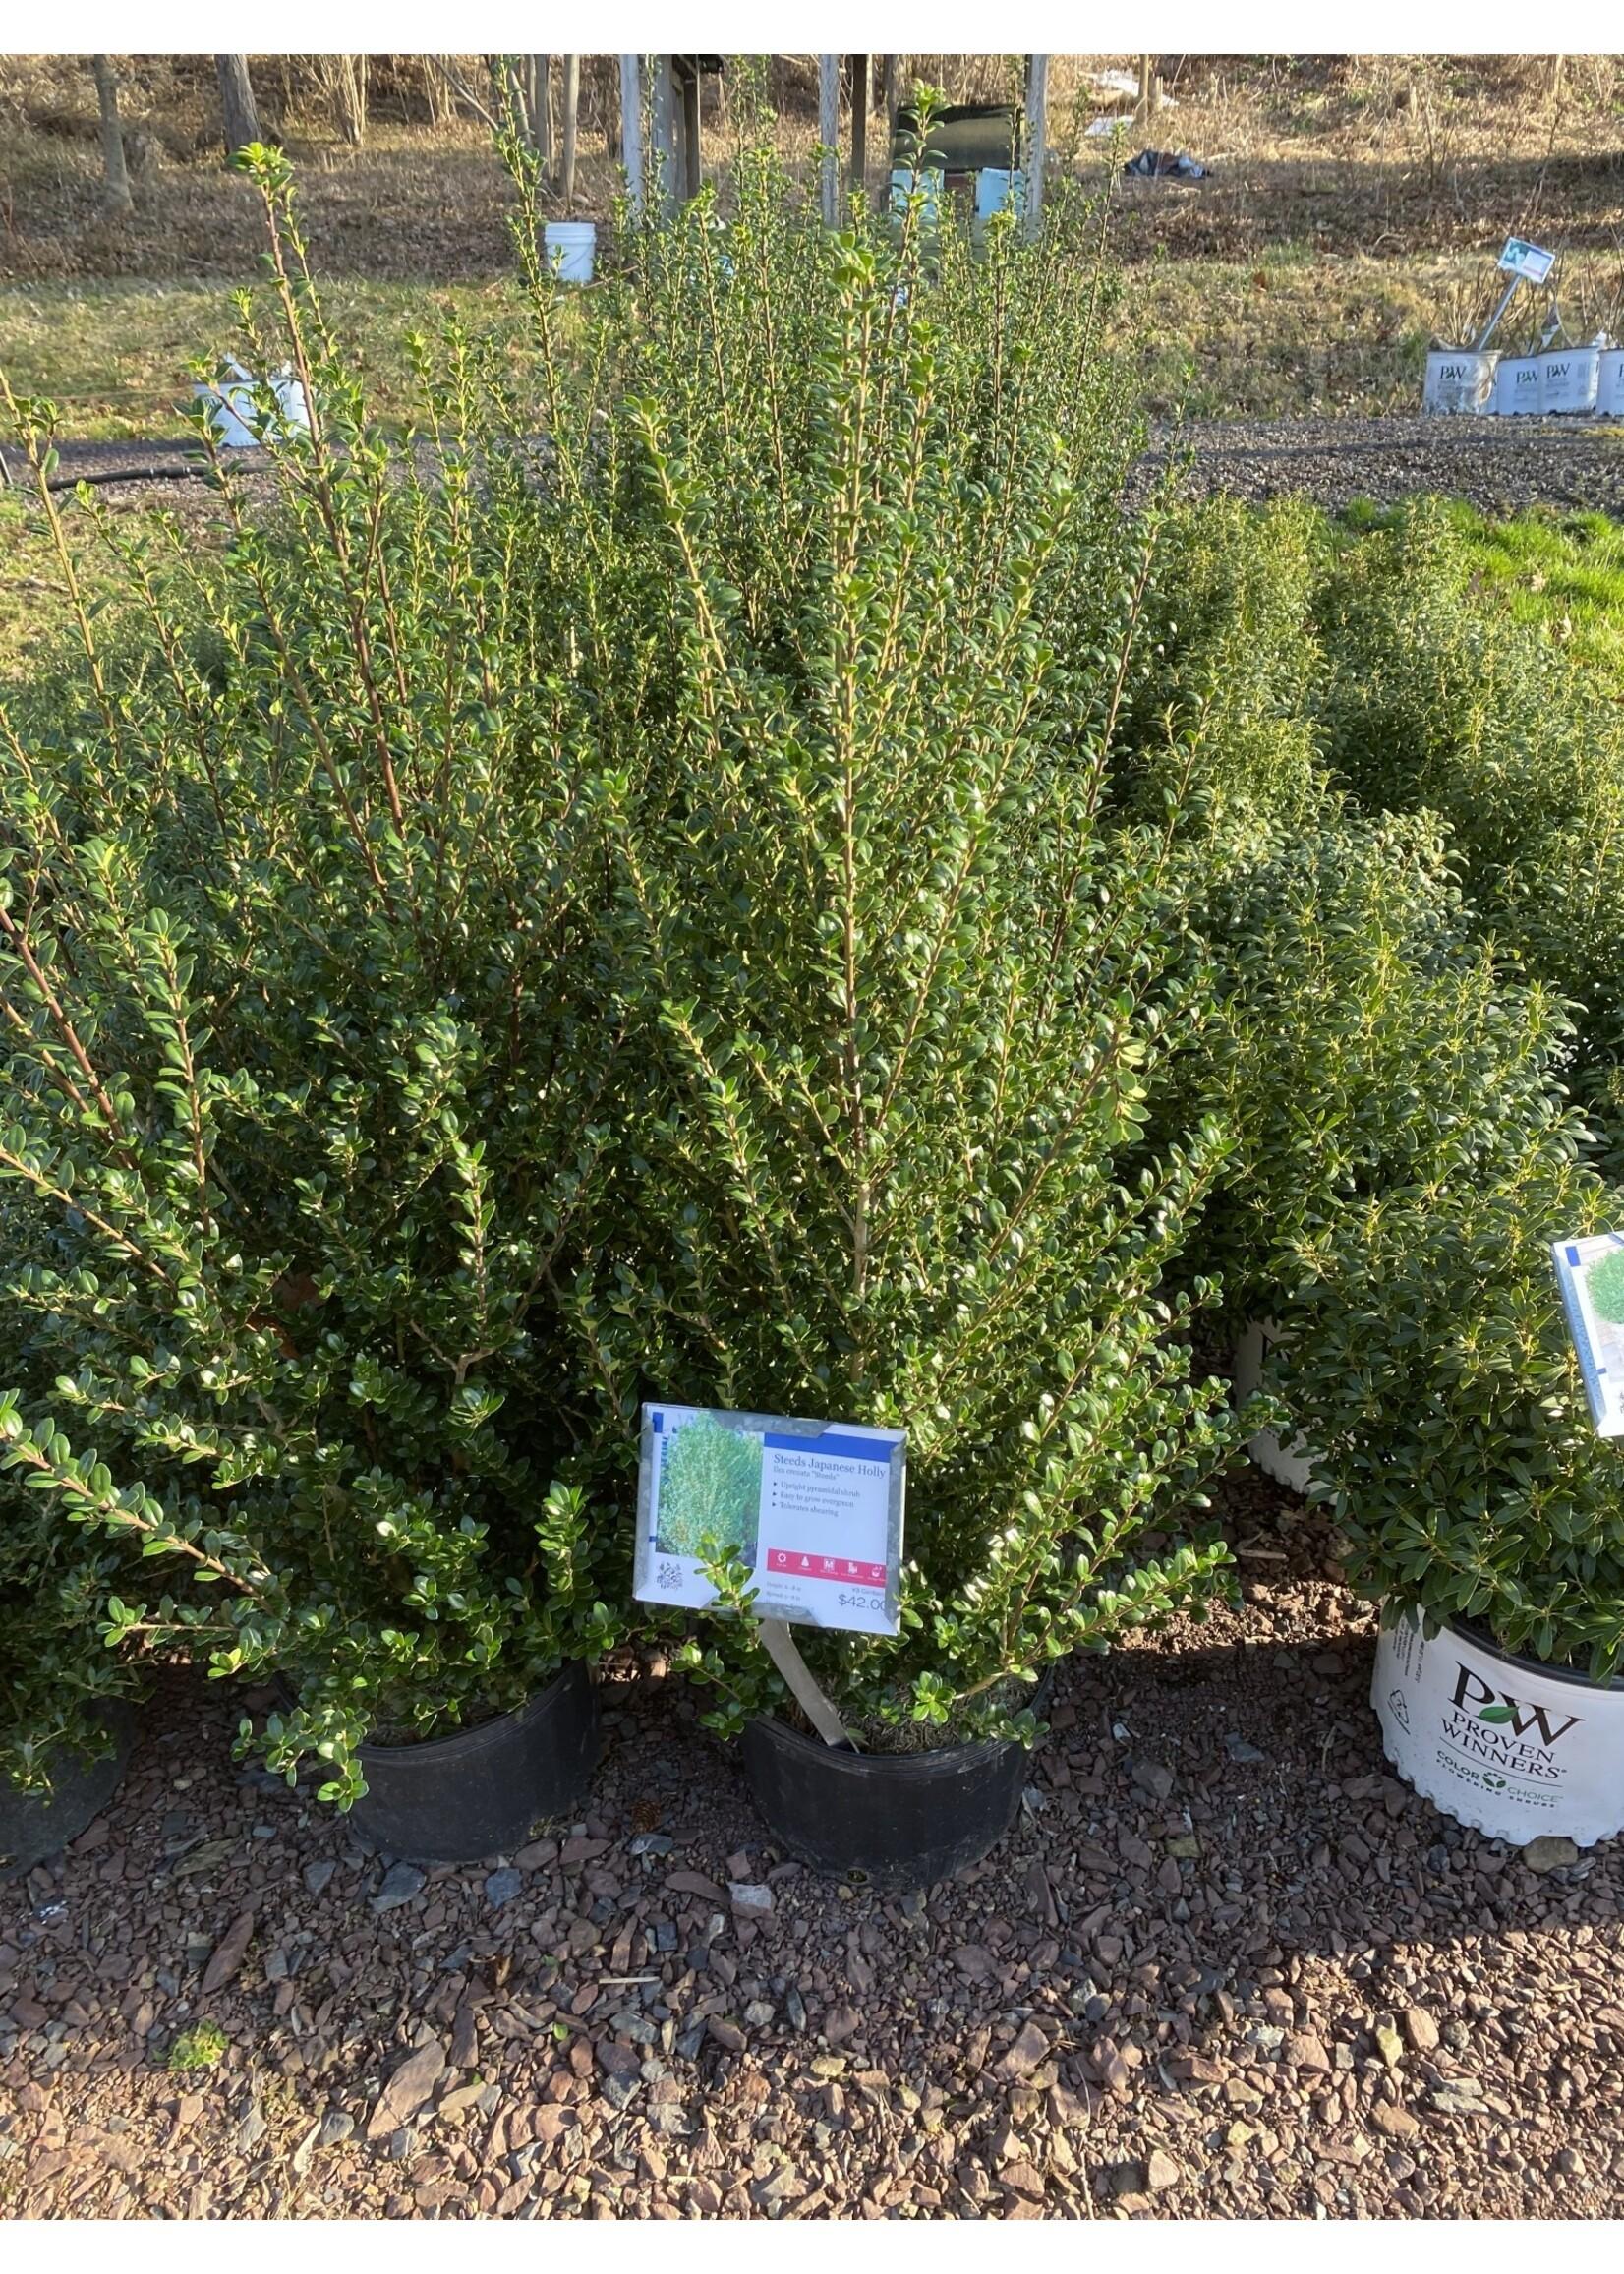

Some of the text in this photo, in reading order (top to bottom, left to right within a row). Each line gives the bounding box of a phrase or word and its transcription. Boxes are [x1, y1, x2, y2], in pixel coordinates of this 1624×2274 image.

[773, 1453, 887, 1479] Steeds Japanese Holly
[780, 1491, 795, 1501] Easy
[822, 1498, 854, 1508] evergreen
[781, 1481, 861, 1498] Upright pyramidal shrub
[780, 1501, 839, 1517] Tolerates shearing
[1453, 1709, 1555, 1763] PROVEN
[1436, 1750, 1479, 1780] COLOR
[1435, 1758, 1555, 1808] FLOWERING SHRUBS
